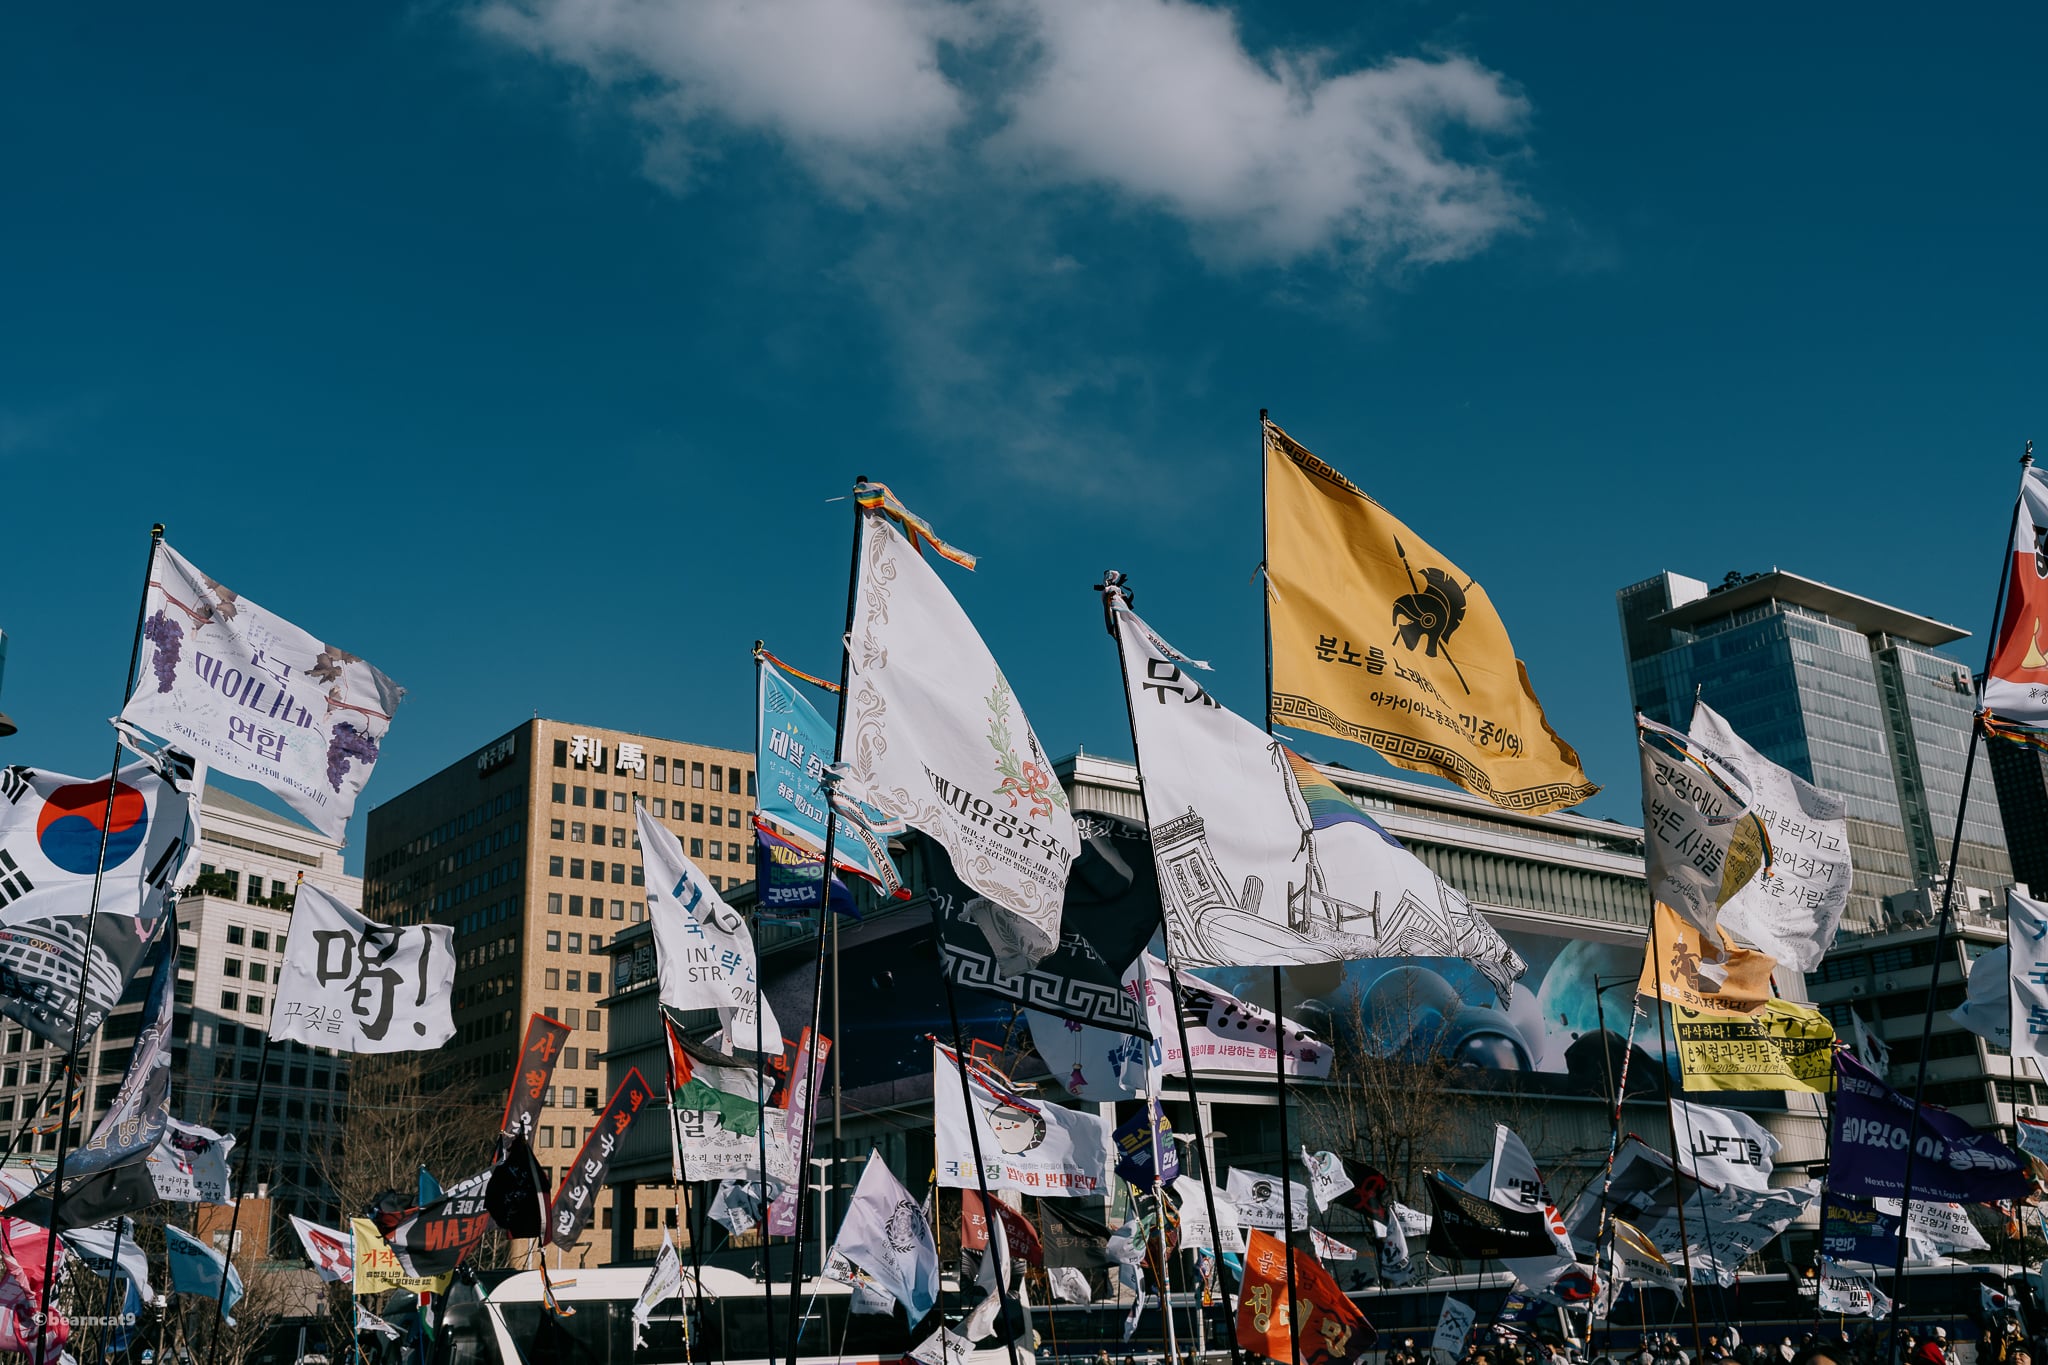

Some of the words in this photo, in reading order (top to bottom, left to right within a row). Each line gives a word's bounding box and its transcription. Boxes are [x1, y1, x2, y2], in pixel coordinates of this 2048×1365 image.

[1315, 634, 1388, 676] 분노를
[228, 716, 289, 763] 연합
[571, 734, 646, 774] 利馬
[768, 727, 805, 770] 제발
[777, 782, 794, 803] 취준
[1655, 761, 1724, 817] 광장에서
[1778, 816, 1841, 852] 부러지고
[1675, 828, 1724, 877] 사람들
[768, 886, 817, 904] 구한다
[1789, 885, 1825, 909] 사람
[284, 1001, 344, 1034] 꾸짖을
[1682, 1024, 1731, 1039] 바삭하다!
[1218, 1046, 1256, 1058] 사랑하는
[713, 1153, 753, 1163] 덕후연합
[945, 1160, 1001, 1180] 국립장
[1045, 1173, 1097, 1190] 반대연대
[1919, 1216, 1948, 1231] 모험가
[1951, 1223, 1970, 1236] 연합
[1823, 1237, 1857, 1252] 구한다
